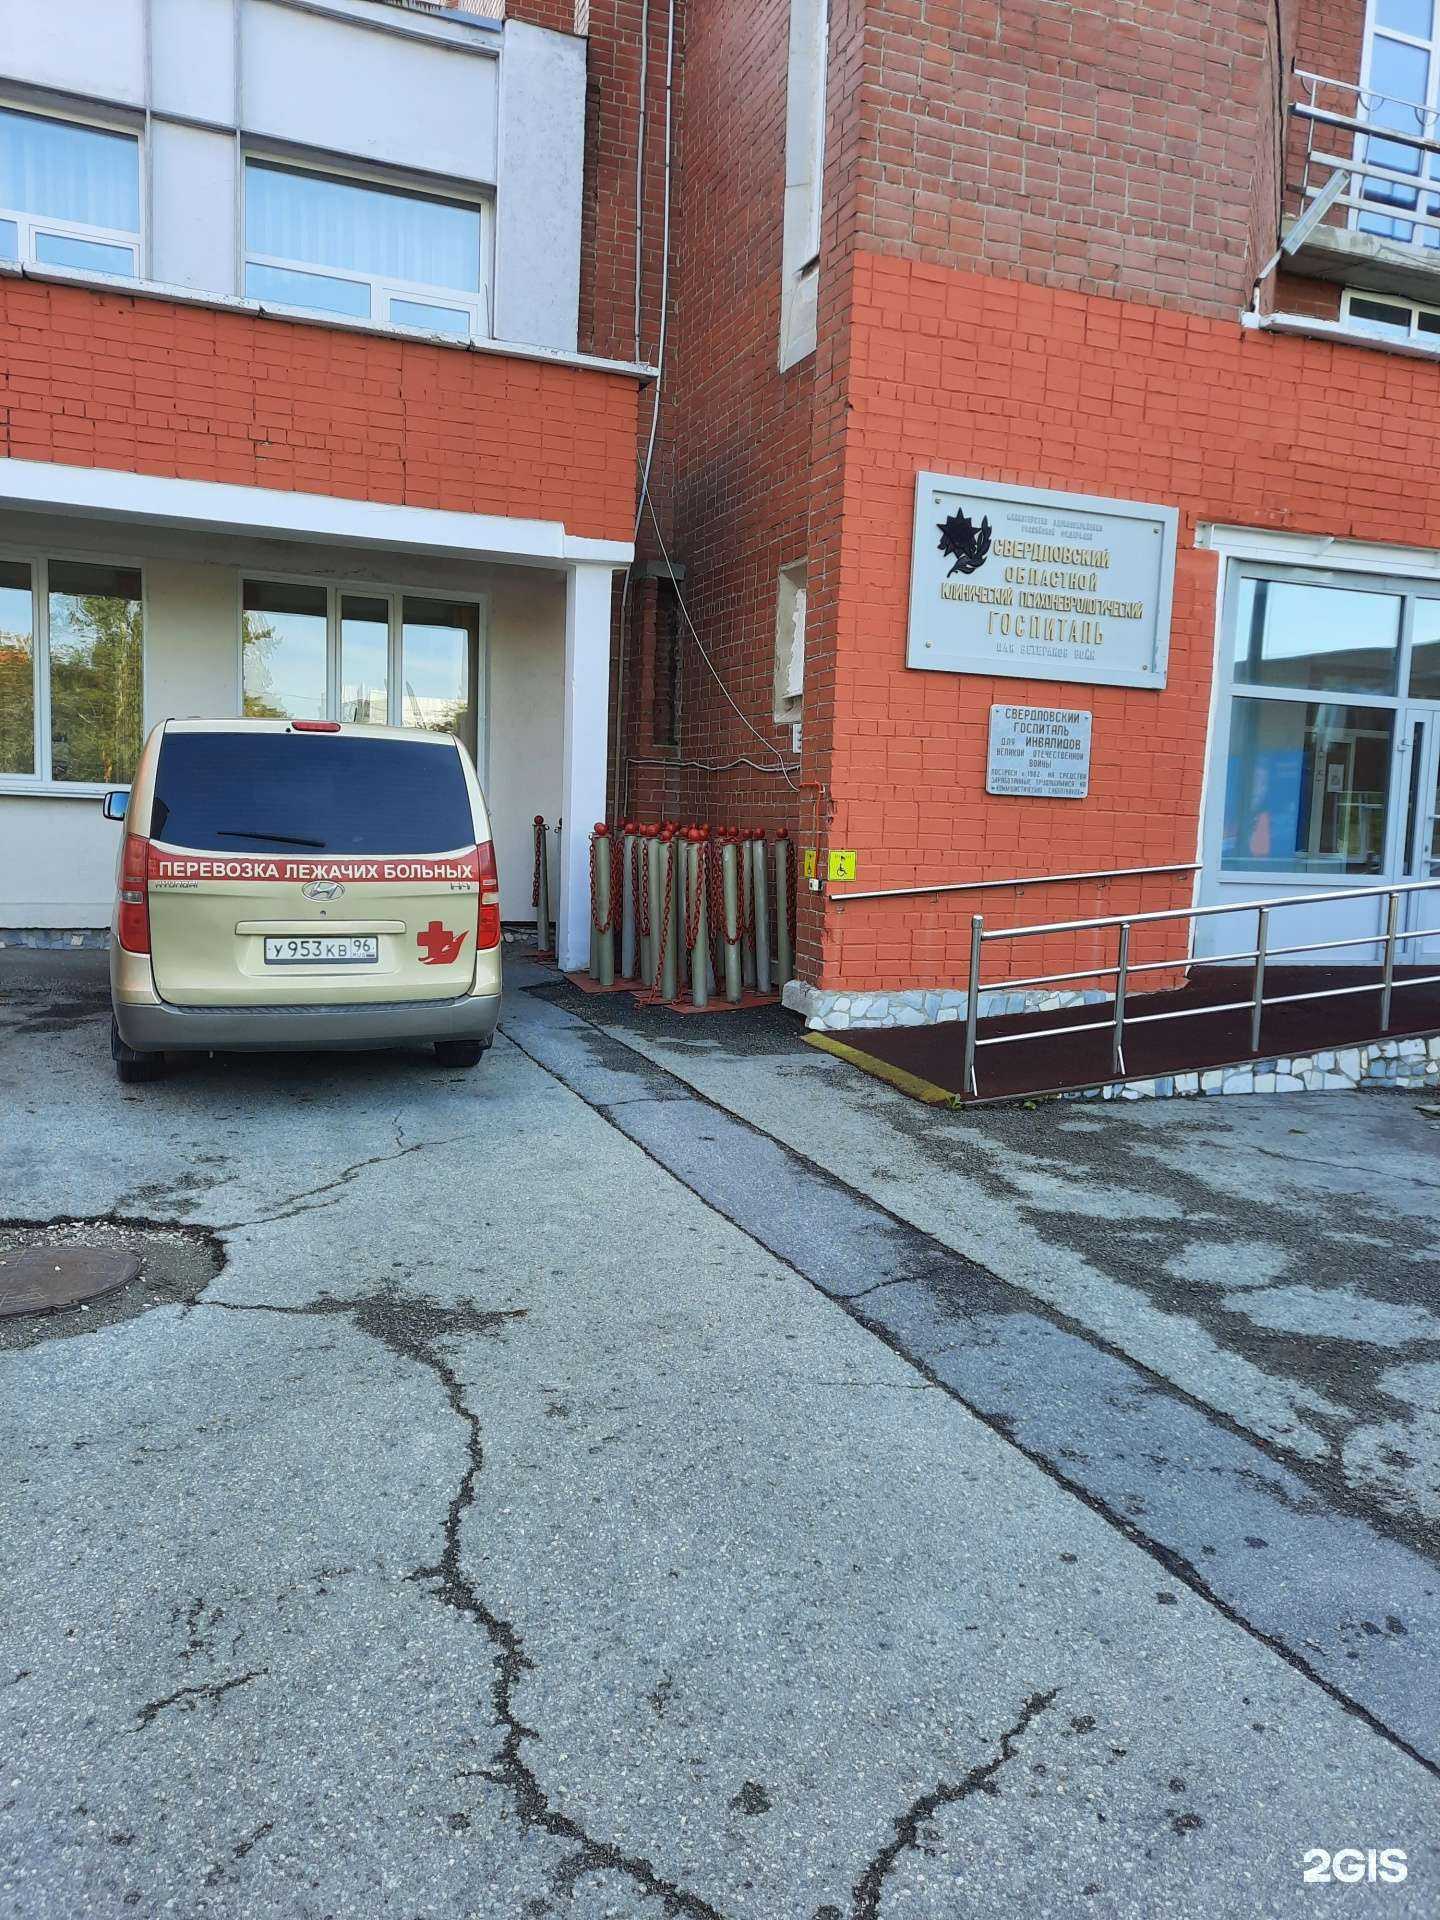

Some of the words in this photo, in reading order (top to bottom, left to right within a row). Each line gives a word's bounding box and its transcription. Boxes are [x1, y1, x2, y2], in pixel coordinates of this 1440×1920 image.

[993, 538, 1111, 569] СВЕРДЛОВСКИЙ
[1005, 566, 1098, 592] ОБЛАСТНОЙ
[940, 582, 1014, 606] КЛИНИЧЕСКИЙ
[1019, 591, 1144, 619] ПСИХОНЕВРОЛОГИЧЕСКИЙ
[987, 611, 1104, 645] ГОСПИТАЛЬ
[1013, 722, 1070, 737] ГОСПИТАЛЬ
[1025, 736, 1081, 750] ИНВАЛИДОВ
[159, 861, 279, 878] ПЕРЕВОЗКА
[284, 863, 379, 879] ЛЕЖАЧИХ
[384, 864, 473, 879] БОЛЬНЫХ
